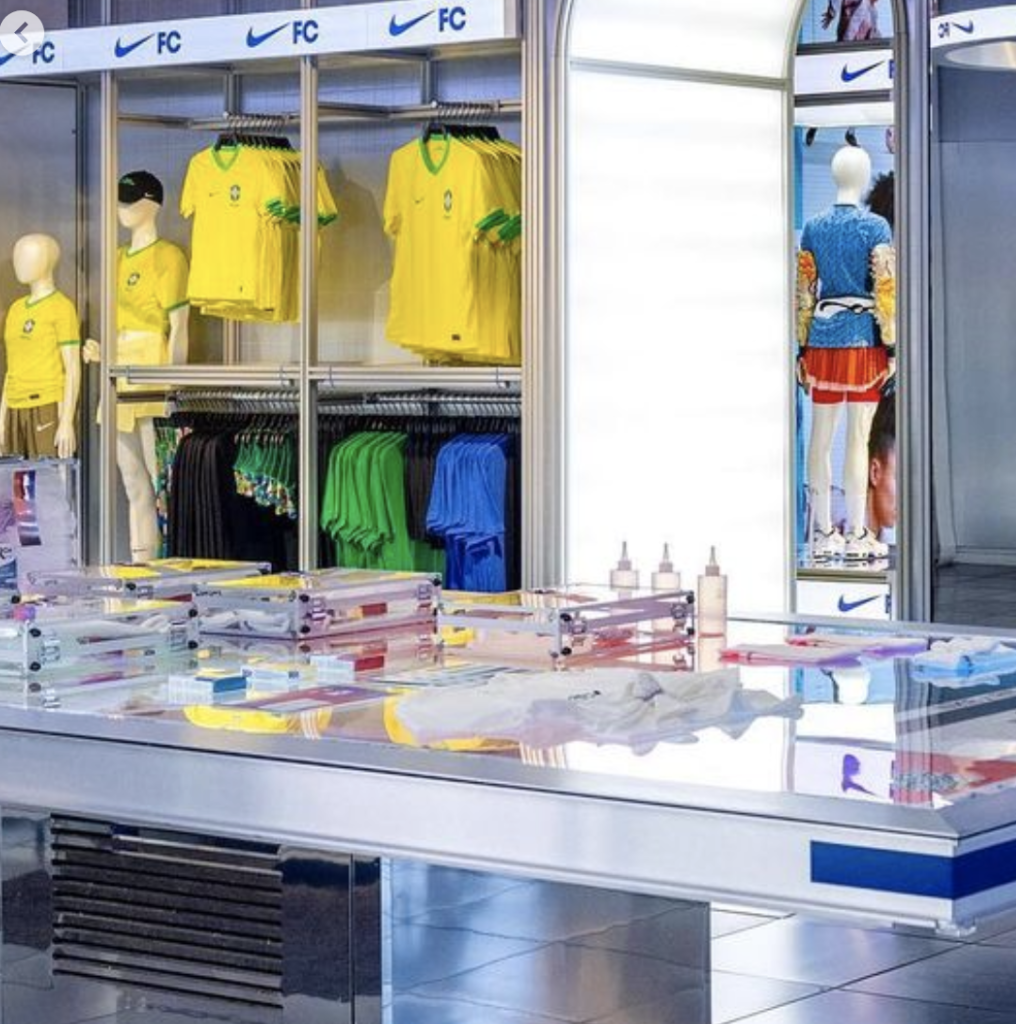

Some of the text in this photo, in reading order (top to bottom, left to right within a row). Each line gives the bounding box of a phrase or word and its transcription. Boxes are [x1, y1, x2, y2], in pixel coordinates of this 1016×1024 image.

[157, 31, 182, 54] FC
[292, 20, 319, 44] FC
[438, 7, 467, 32] FC
